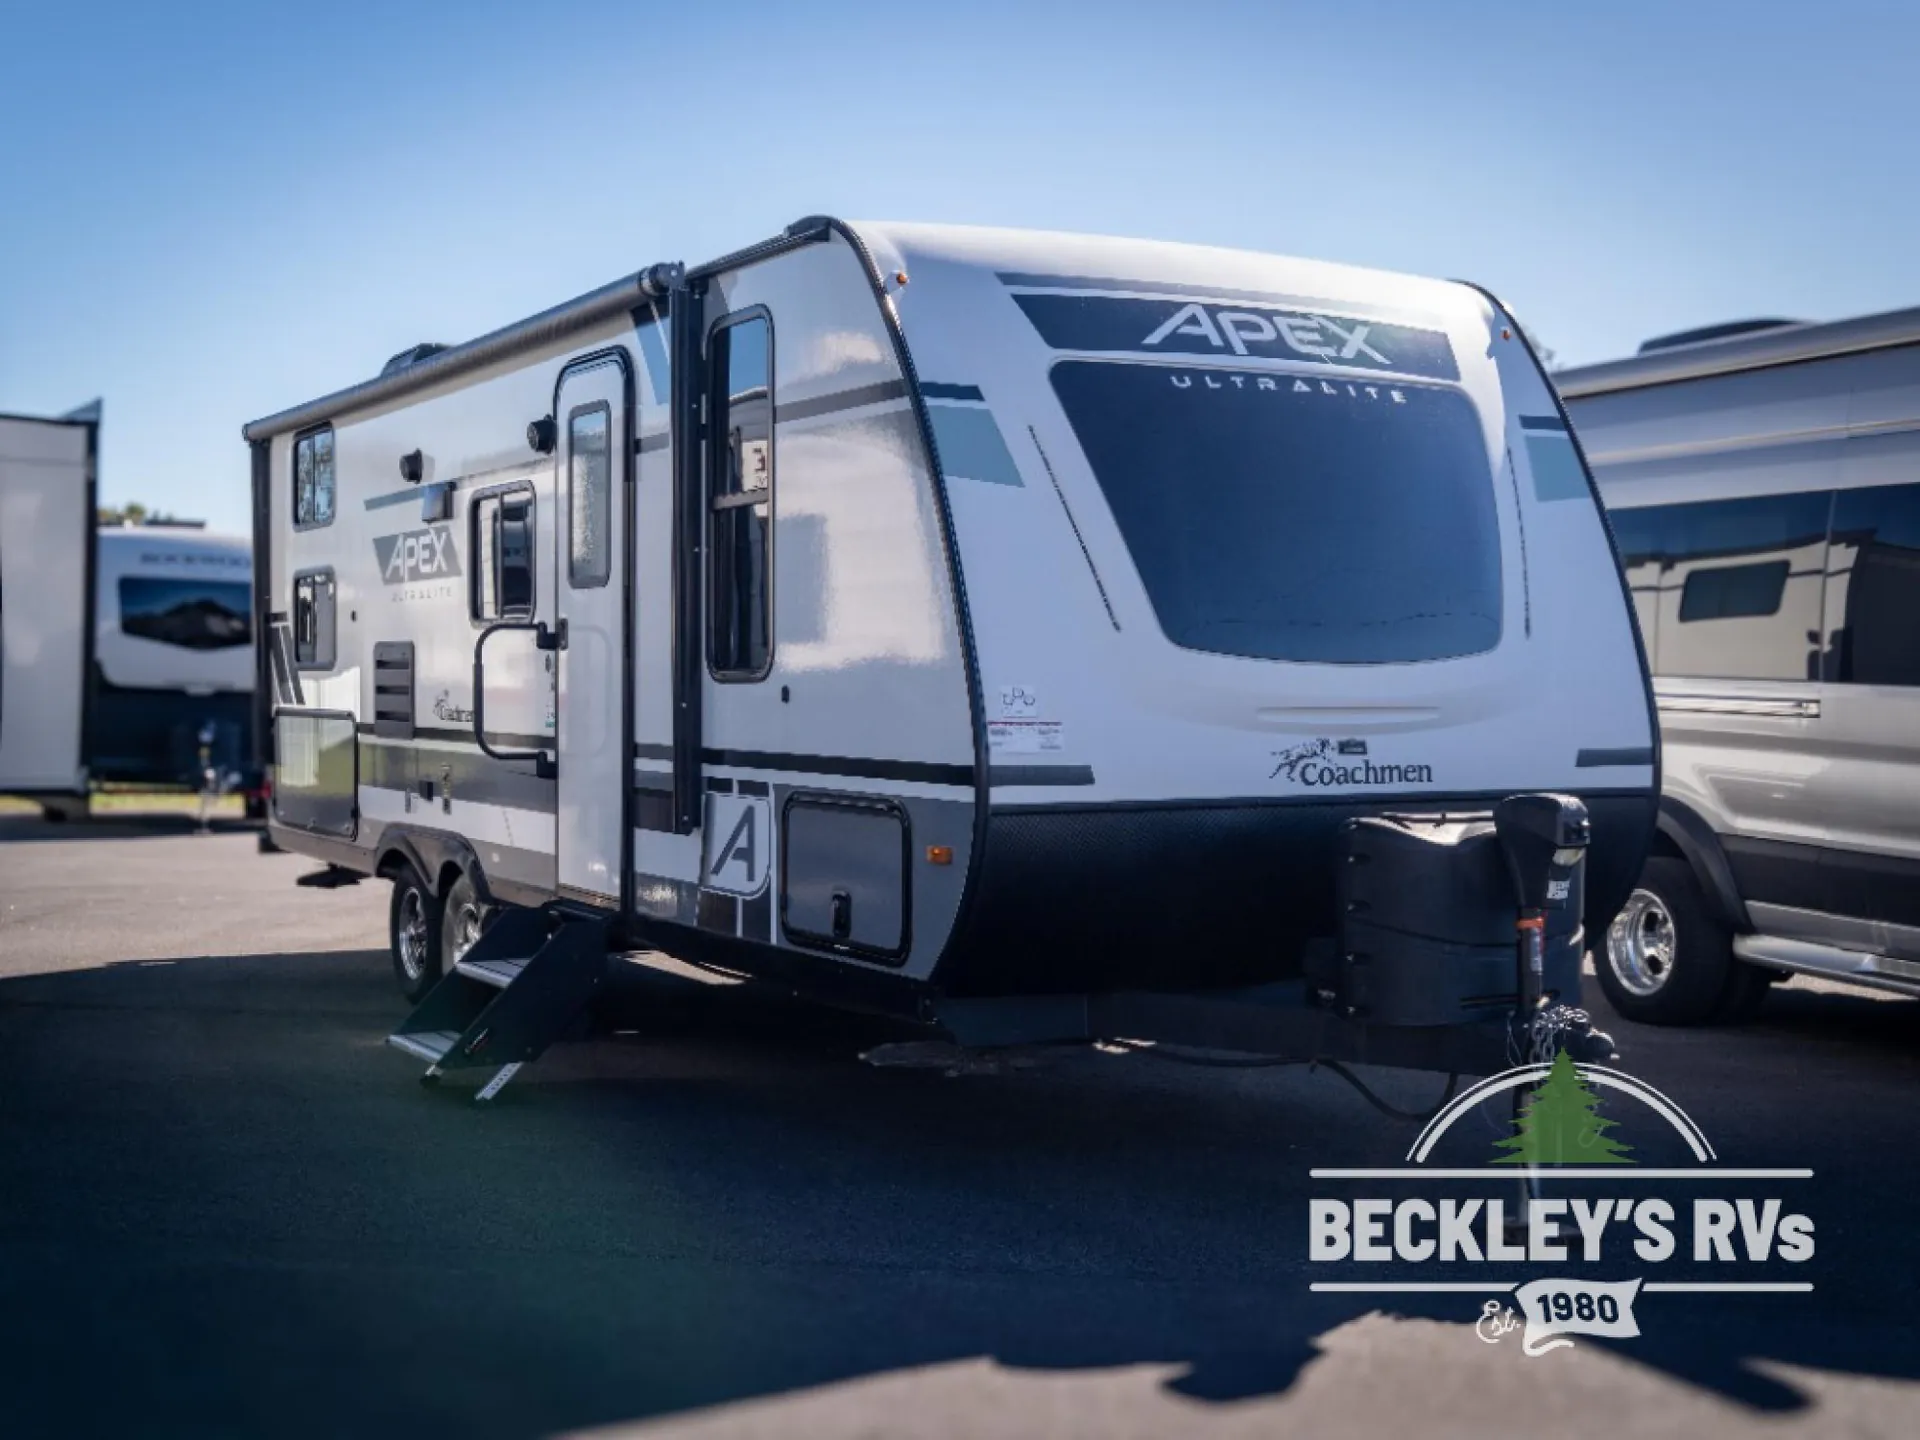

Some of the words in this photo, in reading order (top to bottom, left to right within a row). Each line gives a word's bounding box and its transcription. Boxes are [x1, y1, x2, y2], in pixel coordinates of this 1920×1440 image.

[1141, 303, 1392, 365] APEX
[1170, 375, 1407, 404] ULTRALITE
[385, 527, 449, 583] APEX
[1300, 759, 1433, 786] Coachmen
[710, 805, 755, 881] A
